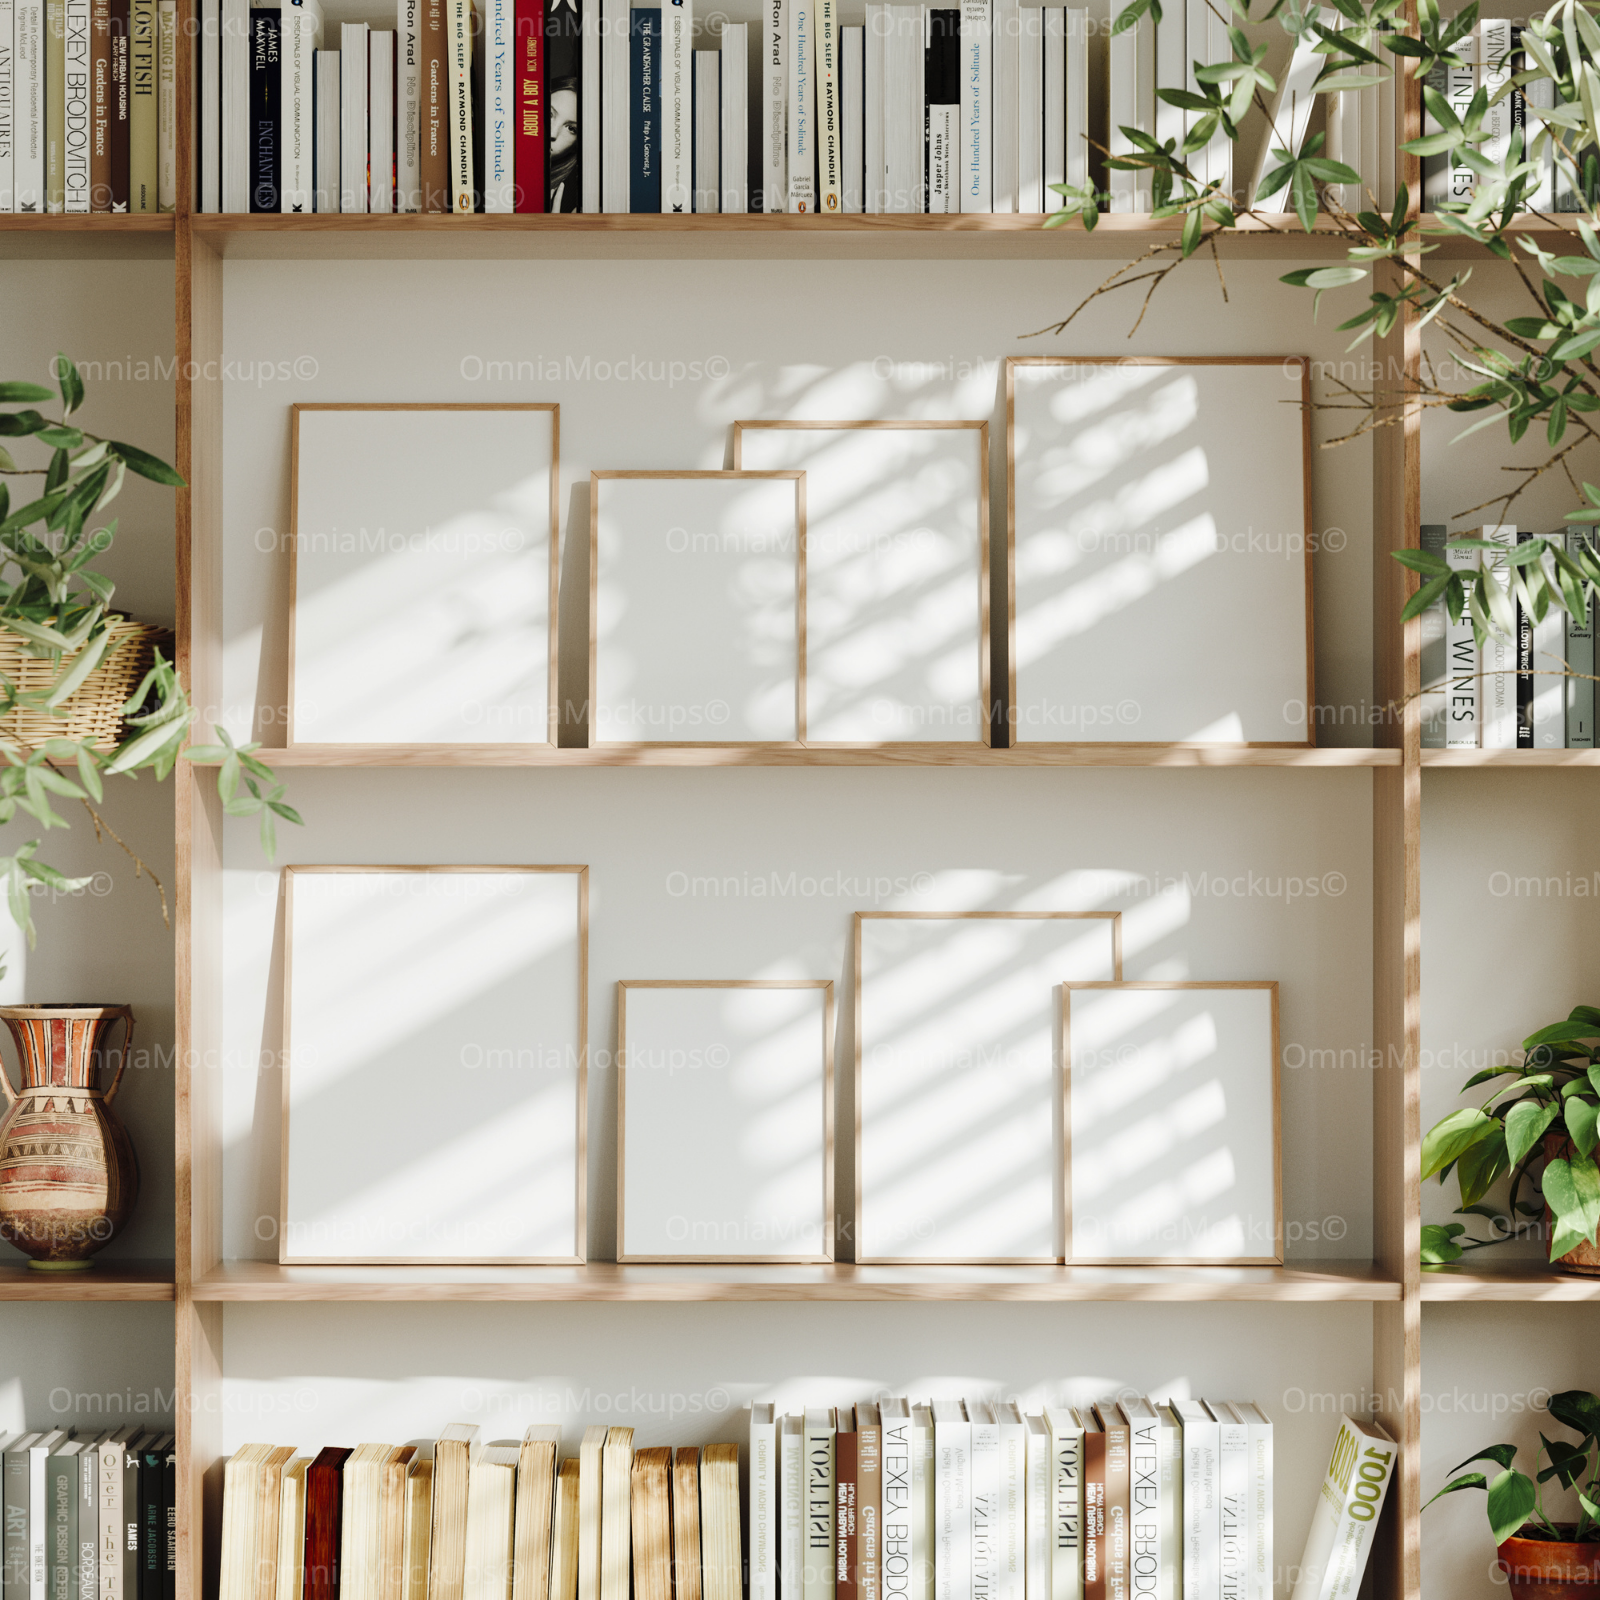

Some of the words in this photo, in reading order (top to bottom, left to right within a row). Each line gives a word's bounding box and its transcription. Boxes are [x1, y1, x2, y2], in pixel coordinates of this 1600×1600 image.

[18, 7, 27, 32] Virginia
[29, 6, 39, 26] Detail
[134, 1, 153, 48] LOST
[407, 0, 416, 28] Ron
[643, 22, 651, 35] THE
[772, 0, 781, 28] Ron
[797, 11, 806, 31] One
[18, 33, 27, 59] McLeod
[119, 36, 127, 55] NEW
[162, 11, 173, 66] MAKING
[255, 20, 266, 71] MAXWELL
[267, 28, 278, 63] JAMES
[293, 15, 301, 59] ESSENTIALS
[407, 33, 416, 66] Arad
[527, 36, 537, 57] HORNBY
[772, 33, 781, 66] Arad
[29, 34, 39, 81] Contemporary
[119, 56, 127, 83] URBAN
[293, 59, 301, 70] OF
[495, 51, 505, 92] Years
[527, 59, 537, 72] NICK
[643, 37, 651, 85] GRANDFATHER
[674, 59, 681, 70] OF
[797, 34, 806, 75] Hundred
[970, 43, 980, 83] Solitude
[96, 58, 107, 104] Gardens
[134, 53, 153, 96] FISH
[162, 68, 173, 83] IT
[293, 71, 301, 96] VISUAL
[405, 76, 416, 96] No
[430, 59, 439, 103] Gardens
[523, 79, 538, 95] BOY
[771, 76, 782, 96] No
[797, 78, 806, 102] Years
[970, 86, 980, 97] of
[29, 83, 39, 119] Residential
[96, 105, 107, 117] in
[119, 84, 127, 120] HOUSING
[430, 105, 439, 116] in
[458, 82, 466, 131] RAYMOND
[495, 97, 505, 115] of
[643, 87, 651, 113] CLAUSE
[797, 105, 806, 115] of
[826, 82, 834, 131] RAYMOND
[970, 100, 980, 125] Years
[29, 120, 39, 159] Architecture
[67, 73, 87, 203] BRODOVITCH
[96, 118, 107, 156] France
[293, 97, 301, 159] COMMUNICATION
[405, 100, 416, 167] Discipline
[430, 119, 439, 156] France
[523, 110, 538, 137] ABOUT
[771, 100, 782, 167] Discipline
[797, 119, 806, 156] Solitude
[258, 120, 274, 208] ENCHANTRESS
[460, 135, 468, 186] CHANDLER
[495, 120, 505, 182] Solitude
[828, 135, 836, 186] CHANDLER
[934, 134, 942, 161] Johns
[970, 129, 980, 171] Hundred
[934, 163, 942, 195] Jasper
[970, 175, 980, 196] One
[1521, 626, 1529, 649] LLOYD
[1452, 639, 1474, 722] WINES
[56, 1475, 69, 1522] GRAPHIC
[147, 1504, 157, 1525] ARNE
[7, 1505, 27, 1540] ART
[167, 1507, 176, 1528] EERO
[56, 1525, 69, 1564] DESIGN
[127, 1523, 138, 1551] EAMES
[147, 1528, 157, 1570] JACOBSEN
[167, 1530, 176, 1571] SAARINEN
